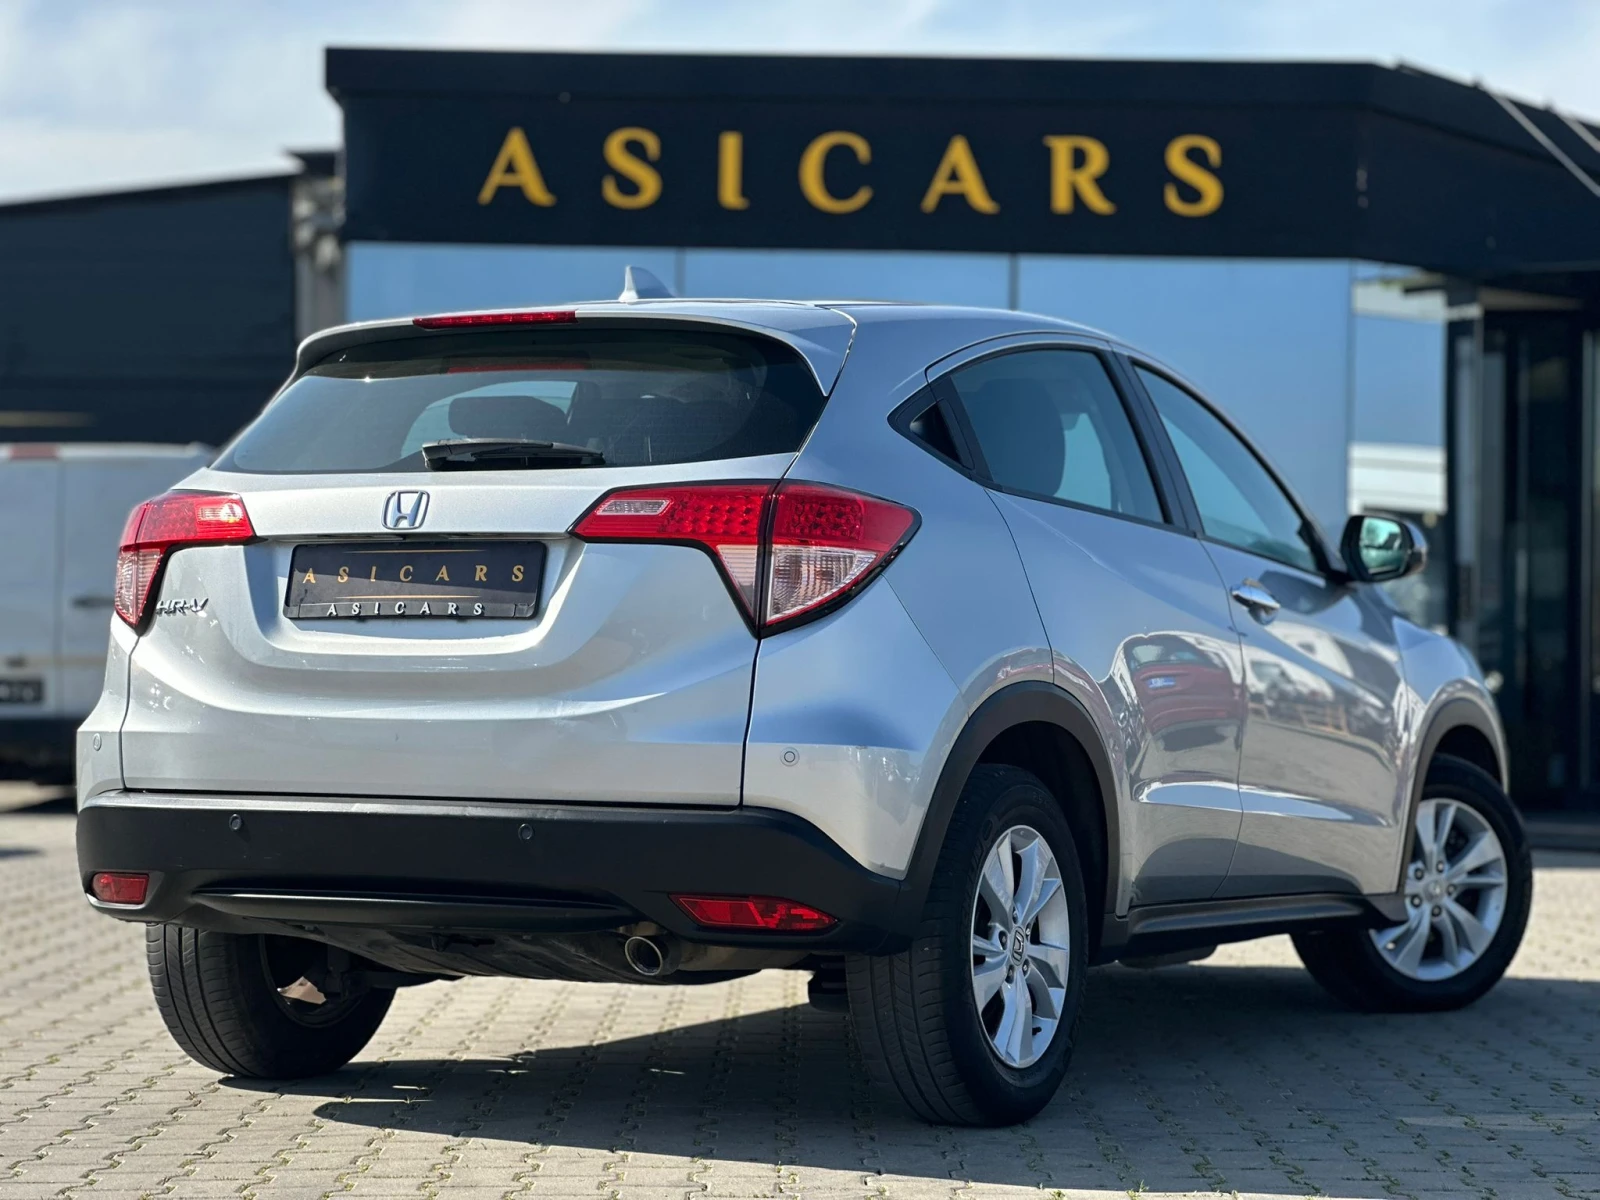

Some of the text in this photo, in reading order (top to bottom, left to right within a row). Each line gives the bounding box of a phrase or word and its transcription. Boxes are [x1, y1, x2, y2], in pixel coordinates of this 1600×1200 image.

[478, 126, 1224, 217] ASICARS
[301, 564, 525, 585] ASICARS
[326, 601, 486, 616] ASICARS
